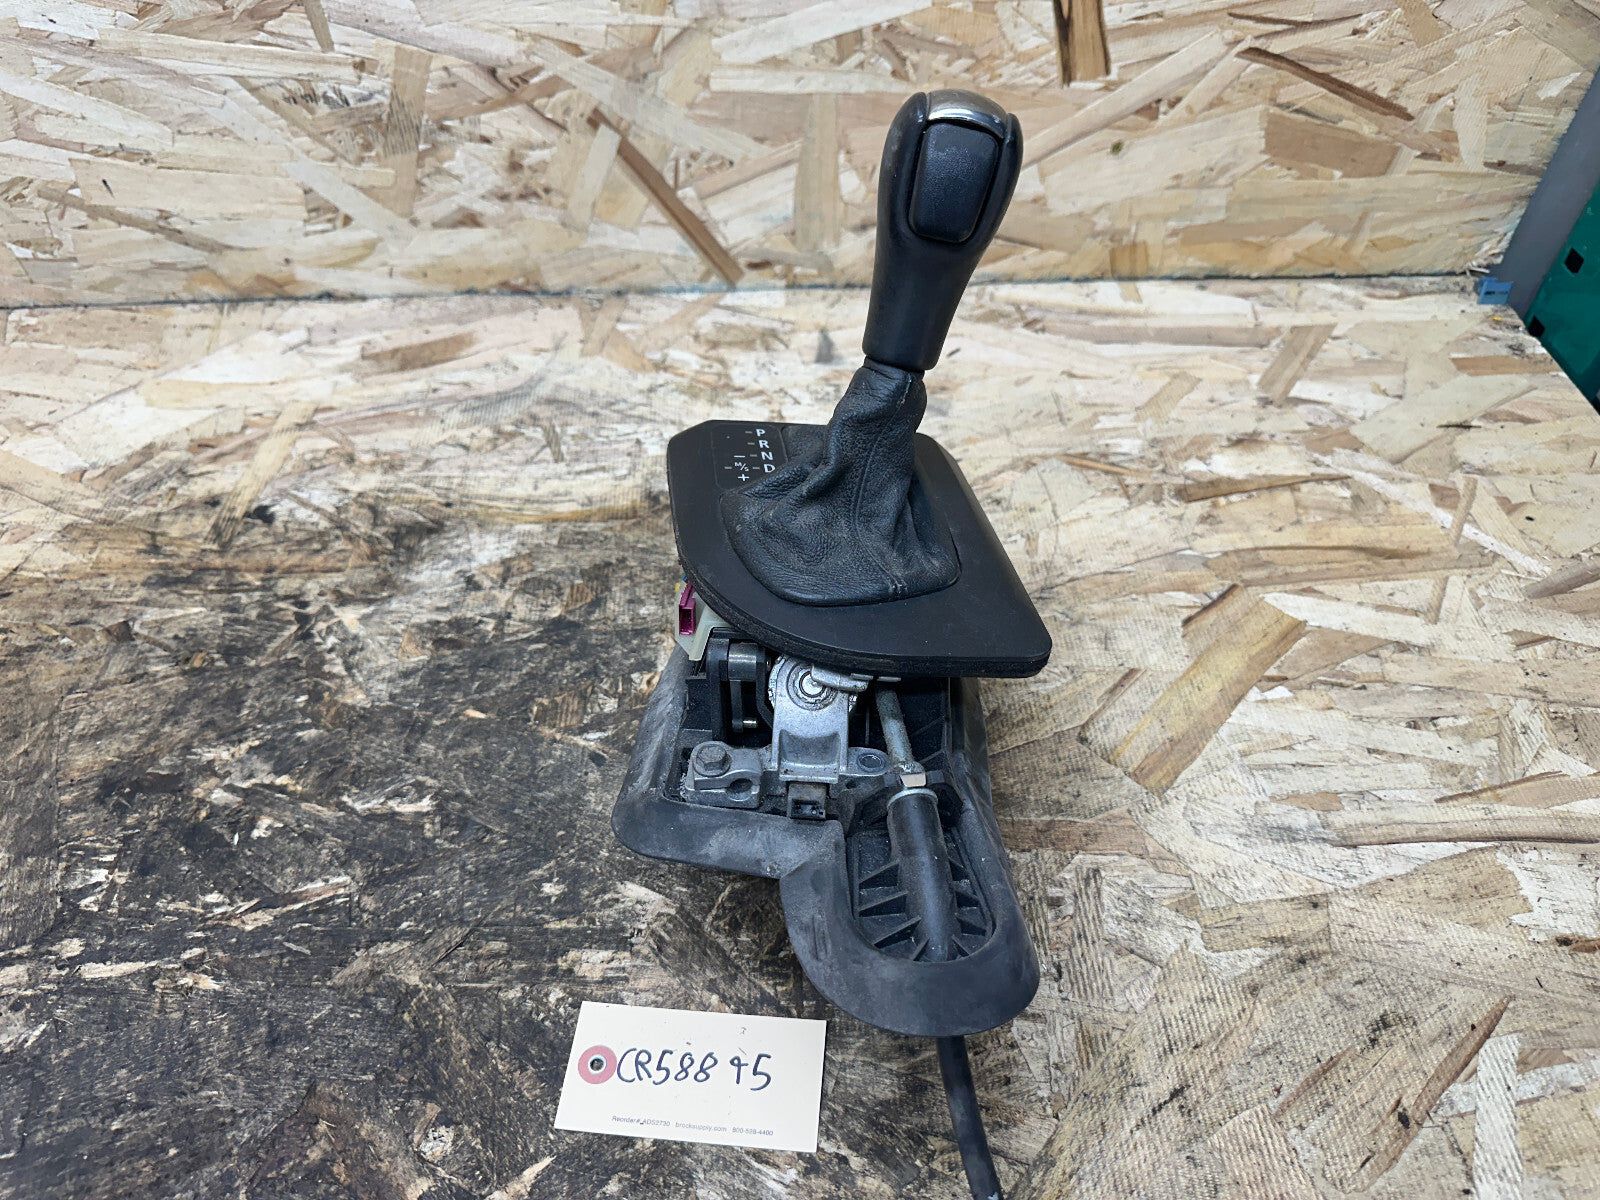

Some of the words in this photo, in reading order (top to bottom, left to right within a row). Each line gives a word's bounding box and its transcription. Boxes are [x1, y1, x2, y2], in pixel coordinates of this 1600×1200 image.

[756, 428, 766, 437] P
[759, 439, 770, 449] R
[761, 451, 774, 461] N
[763, 463, 776, 473] D
[675, 1121, 727, 1132] brocksupply.com
